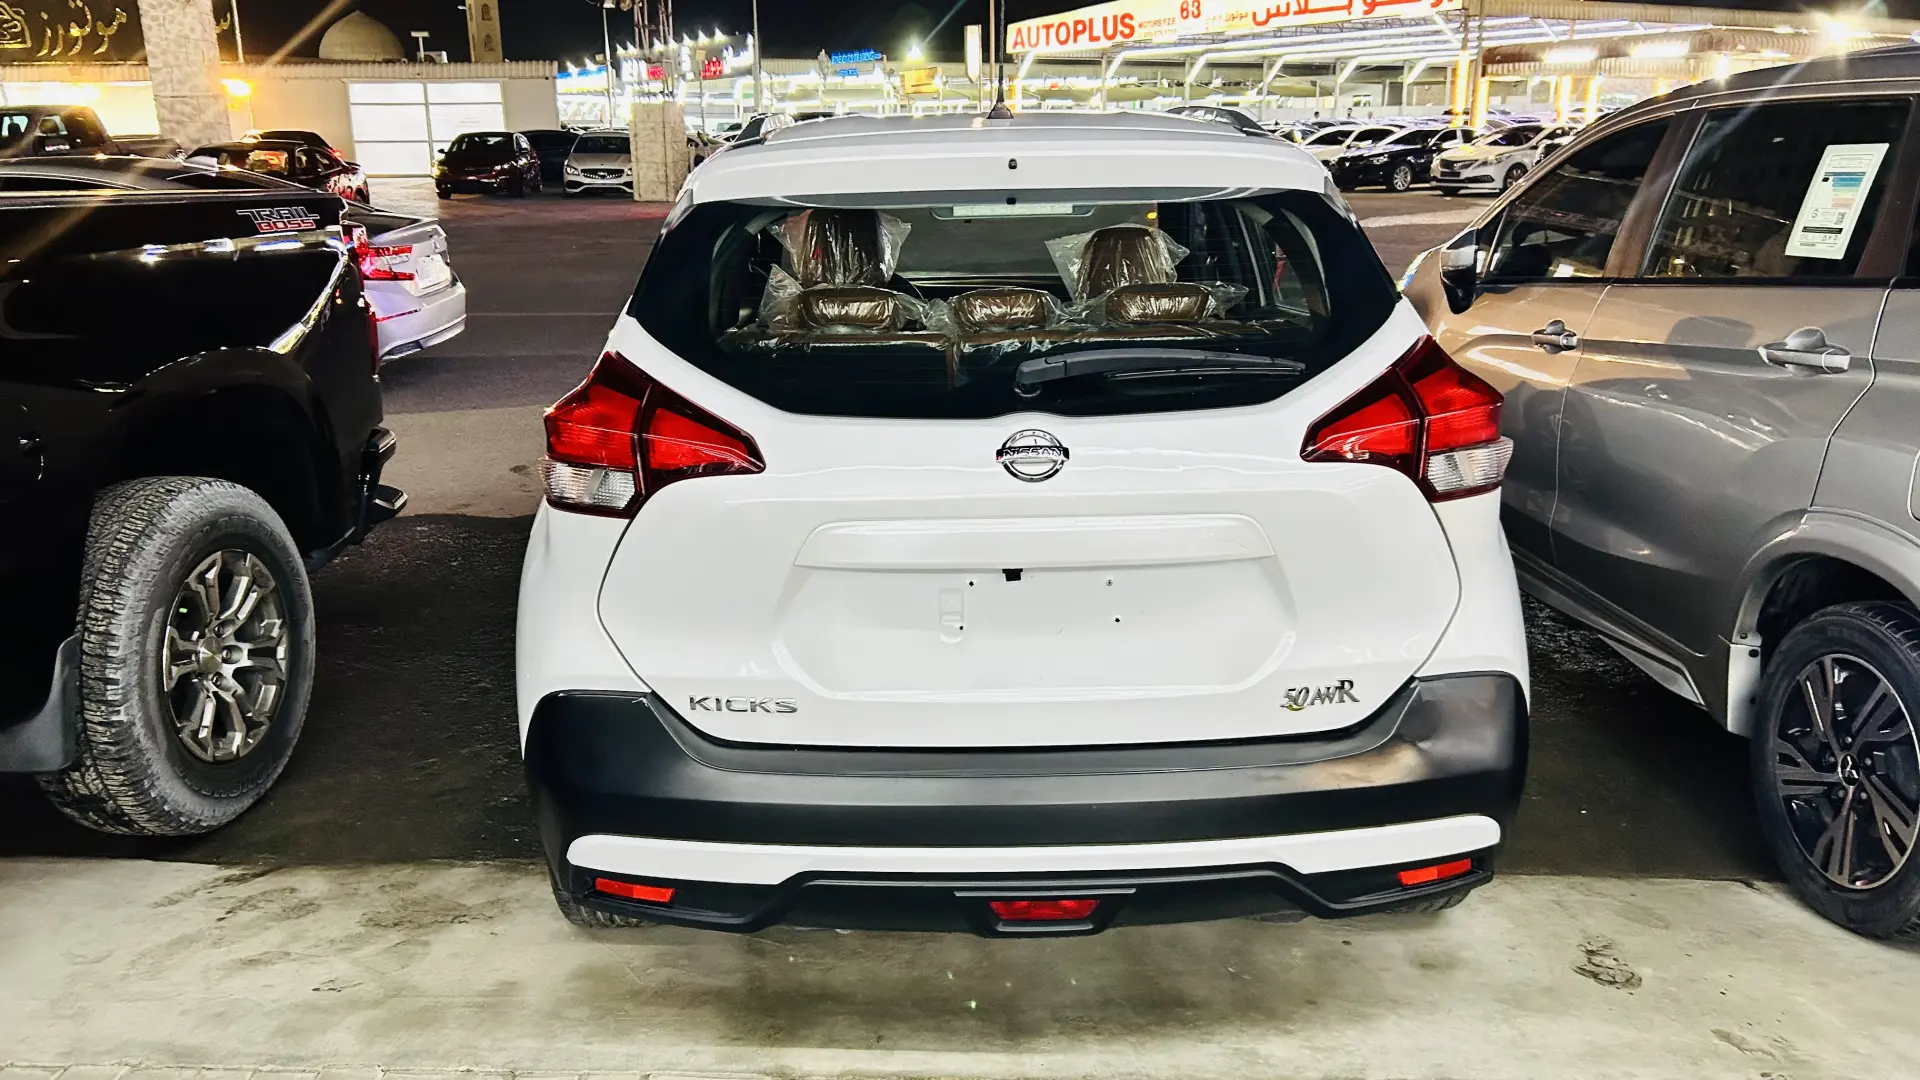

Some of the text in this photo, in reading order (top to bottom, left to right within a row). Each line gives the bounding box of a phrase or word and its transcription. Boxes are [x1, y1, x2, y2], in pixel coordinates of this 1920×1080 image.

[1180, 0, 1201, 19] 63
[1012, 12, 1135, 49] AUTOPLUS
[236, 206, 320, 222] TRAIL
[255, 219, 316, 232] BOSS
[1003, 447, 1063, 457] NISSAN
[688, 695, 798, 713] KICKS
